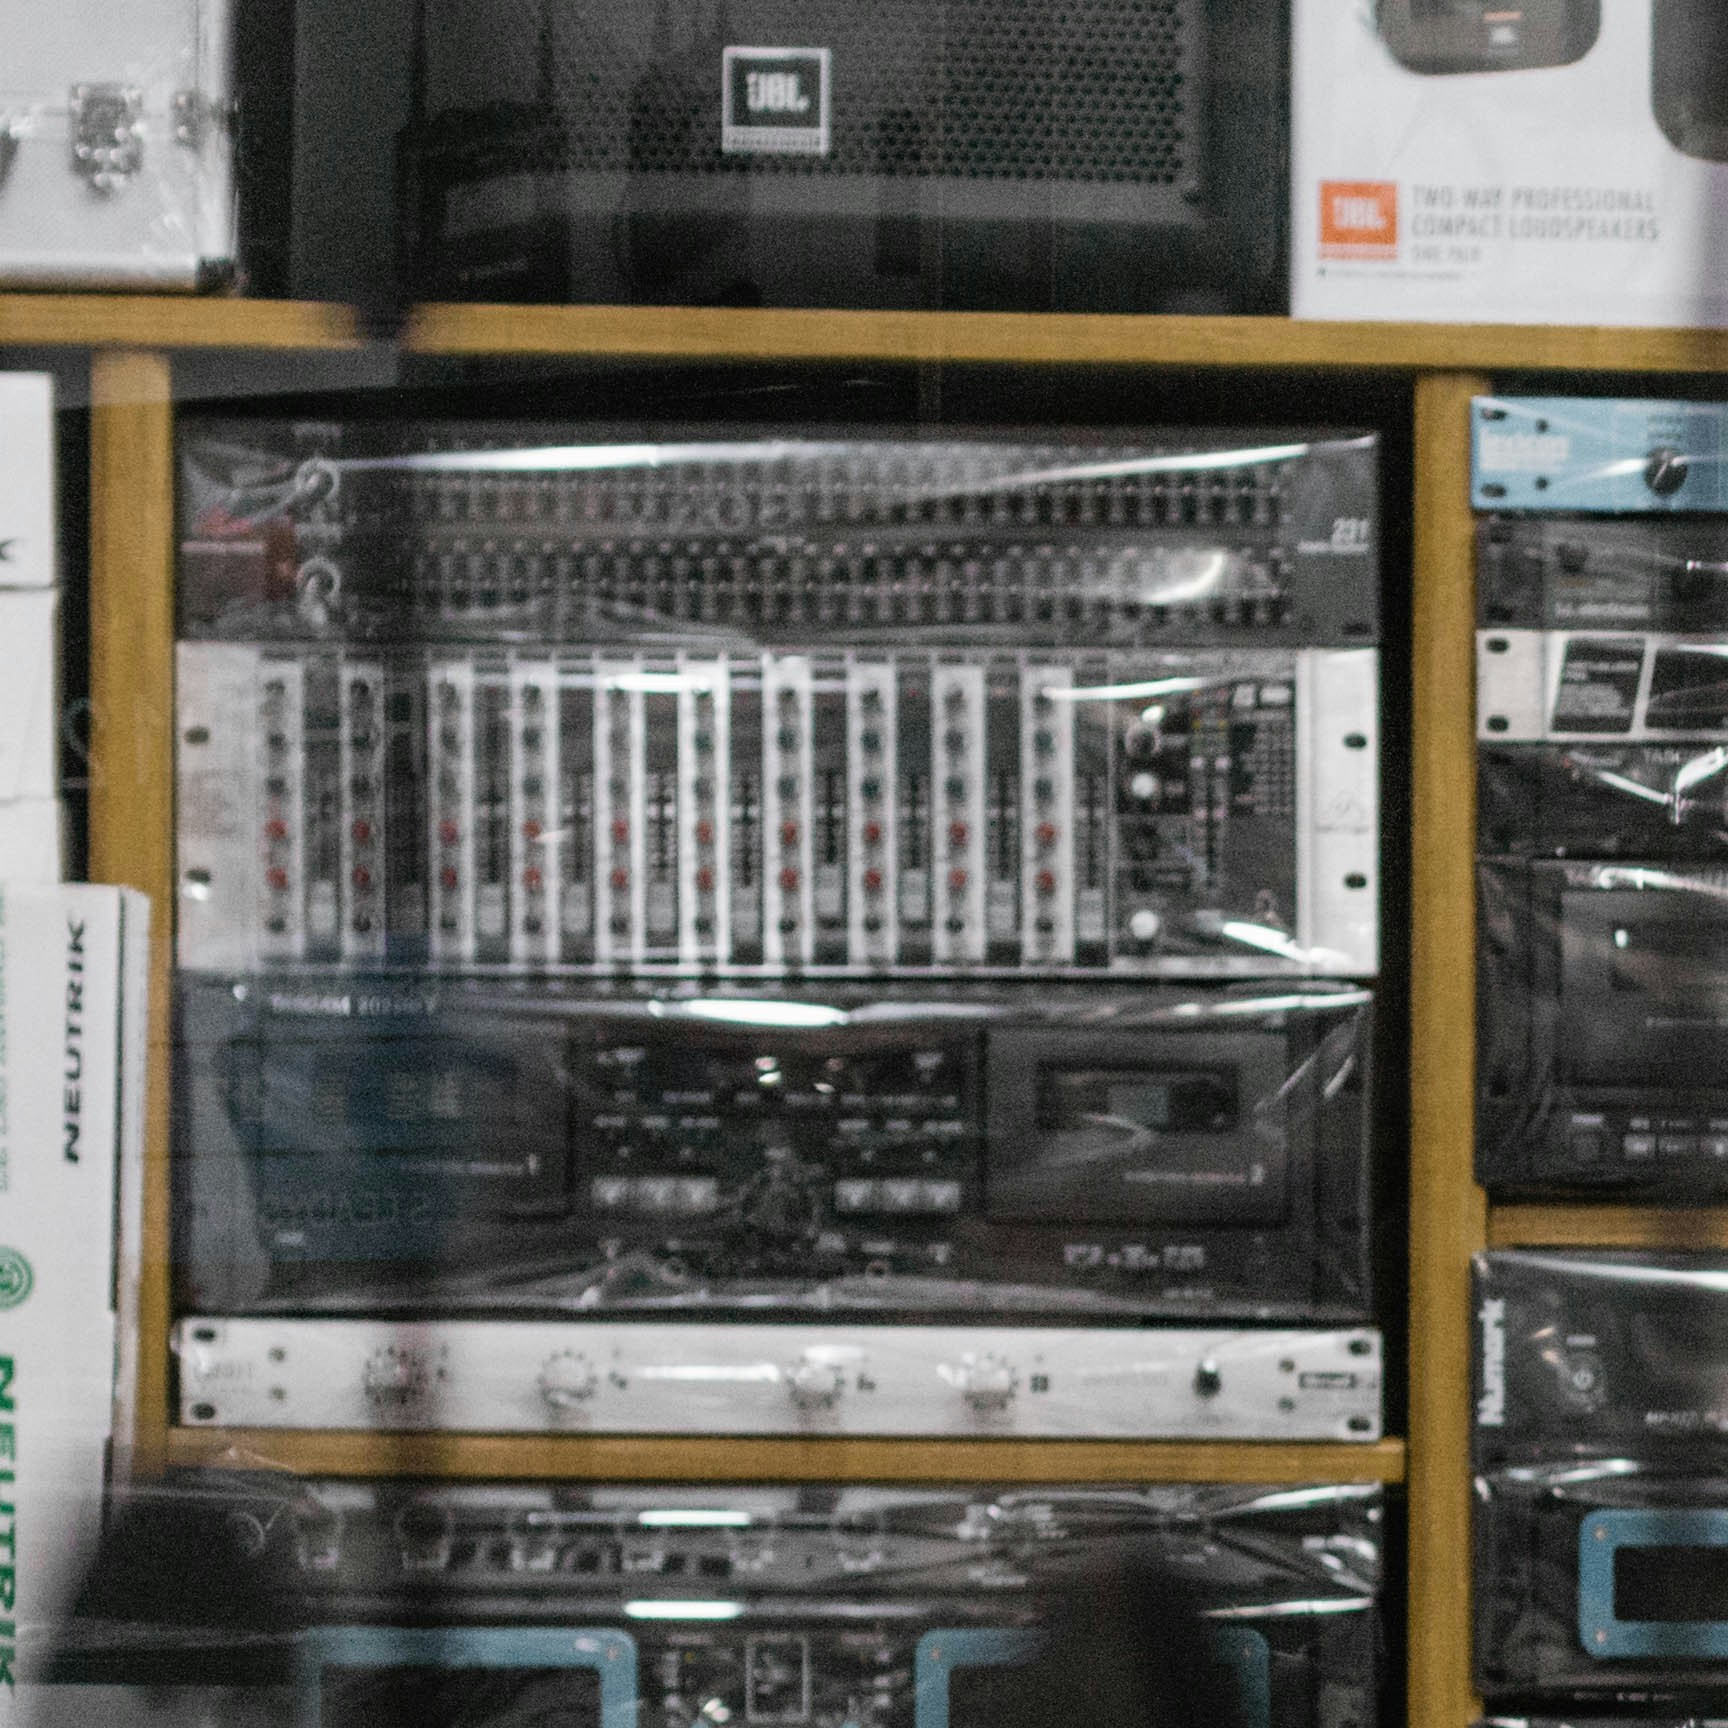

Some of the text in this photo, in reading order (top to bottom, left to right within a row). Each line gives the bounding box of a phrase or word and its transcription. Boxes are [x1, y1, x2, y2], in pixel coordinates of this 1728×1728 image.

[746, 72, 806, 112] JBL
[1511, 186, 1655, 212] PROFESSIONAL
[1411, 214, 1660, 242] COMPACT LOUDSPEAKERS
[61, 918, 87, 1164] NEUTRIK
[1477, 1298, 1505, 1426] Numark
